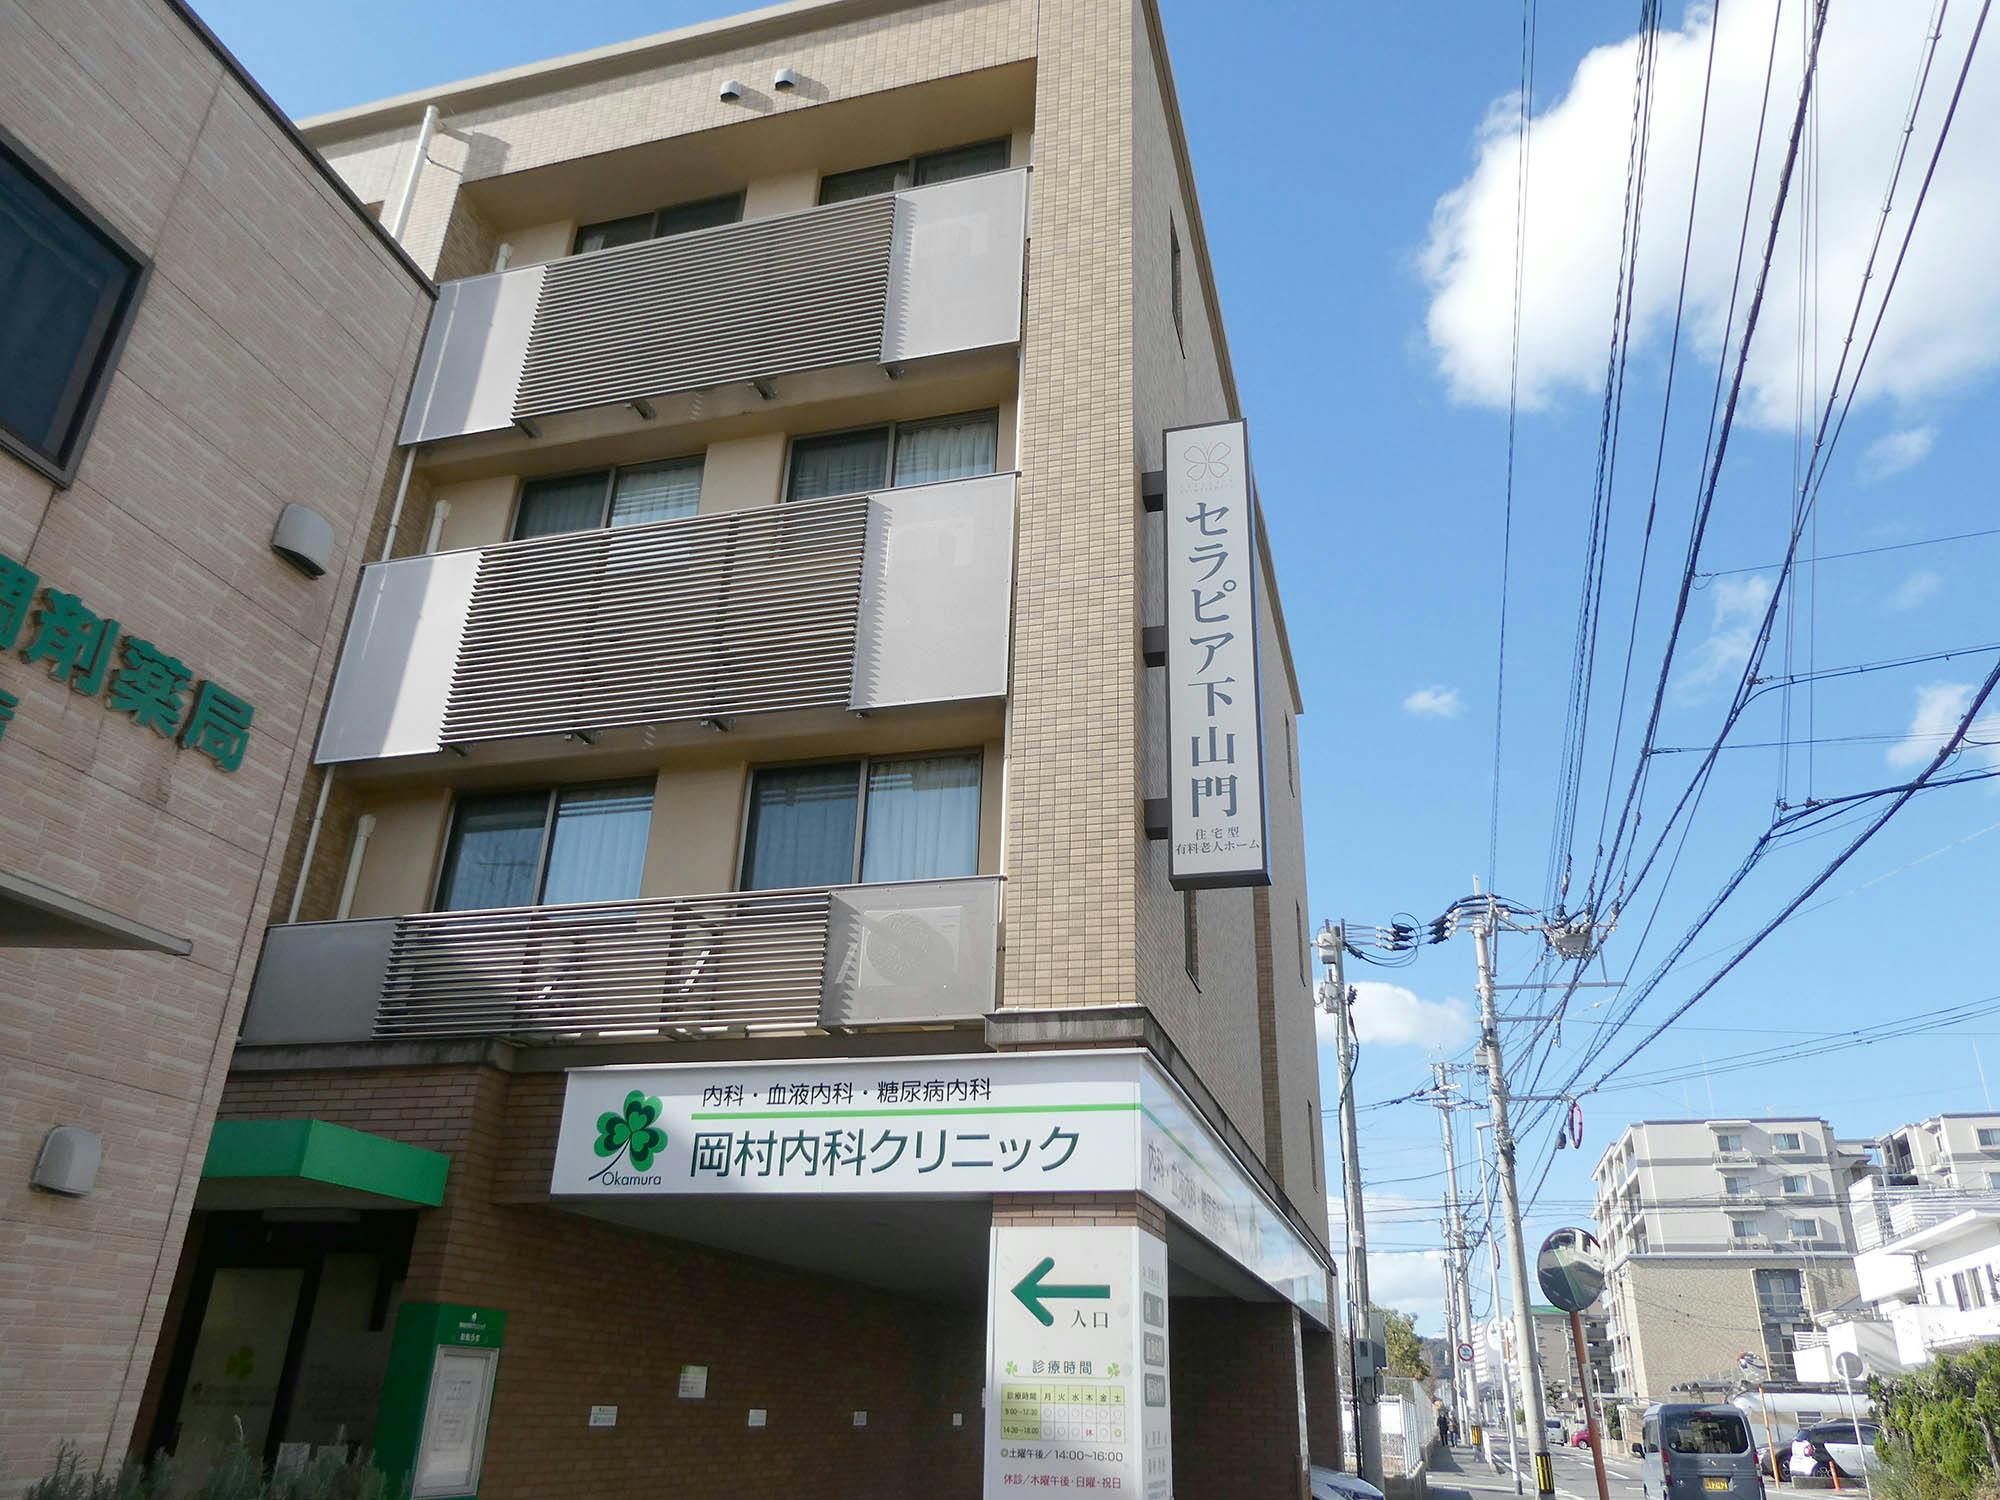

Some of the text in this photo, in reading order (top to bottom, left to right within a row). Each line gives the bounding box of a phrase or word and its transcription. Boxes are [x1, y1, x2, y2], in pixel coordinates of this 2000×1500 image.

[1186, 502, 1238, 818] セラピア下山門
[1195, 826, 1239, 841] 住宅型
[1176, 840, 1259, 855] 有料老人ホーム
[702, 1077, 992, 1107] 内科・血液内科・糖尿病内科
[690, 1126, 1080, 1177] 岡村内科クリニック
[602, 1171, 662, 1186] Okamura
[1071, 1310, 1109, 1328] 入口
[1032, 1360, 1092, 1375] 診療時間
[1058, 1392, 1066, 1401] 火
[1072, 1392, 1080, 1401] 水
[1114, 1394, 1121, 1402] 土
